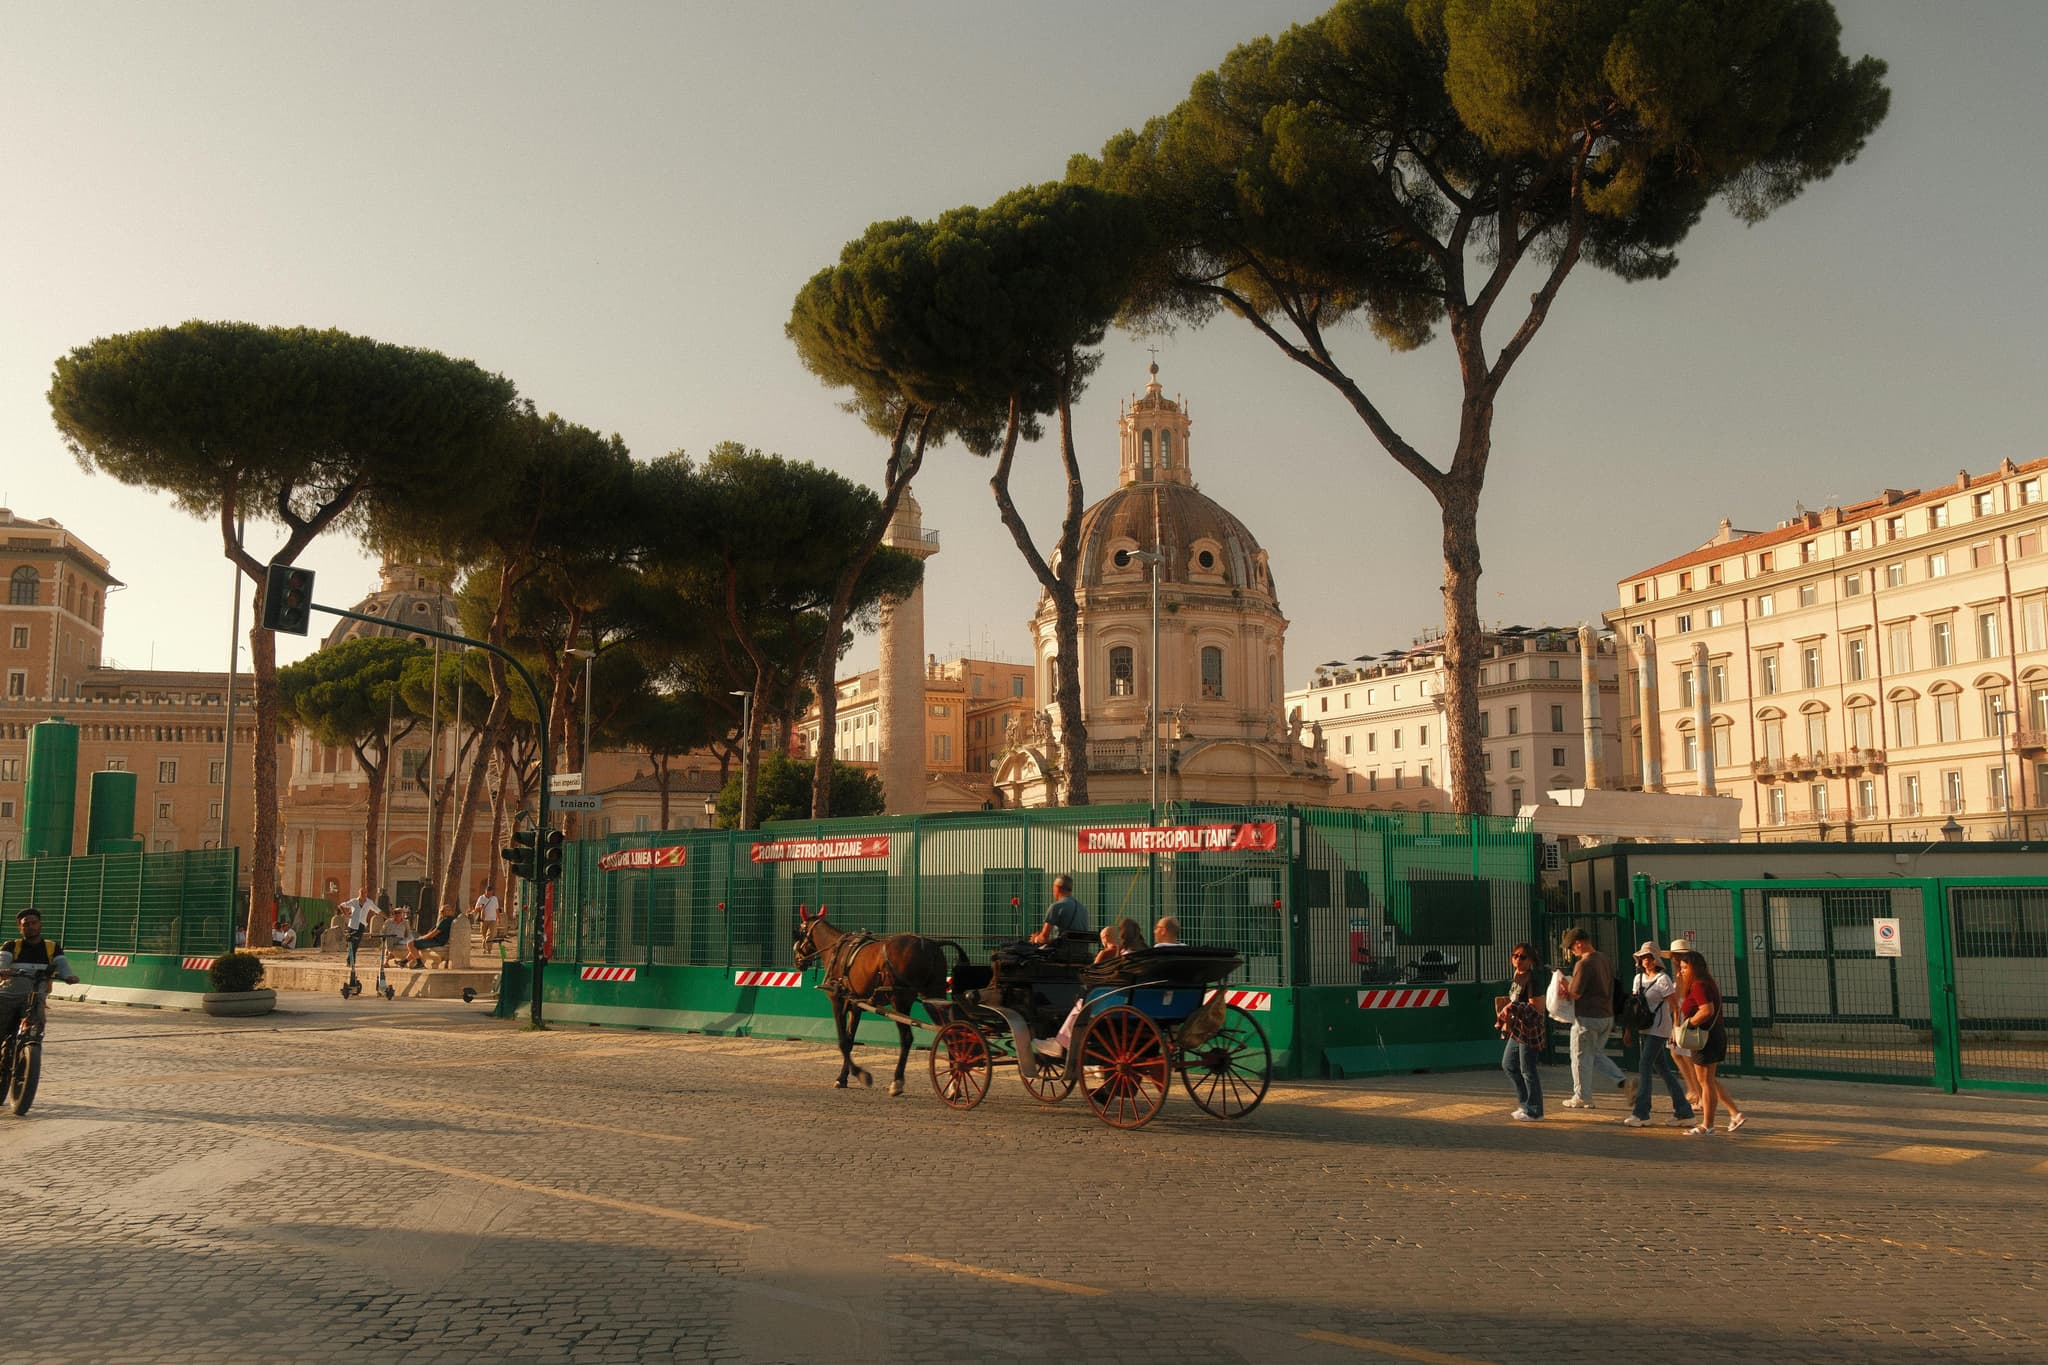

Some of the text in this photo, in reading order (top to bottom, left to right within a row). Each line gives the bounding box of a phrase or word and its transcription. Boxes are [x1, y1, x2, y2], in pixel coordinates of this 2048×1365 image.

[560, 799, 596, 808] traiano
[1088, 829, 1238, 850] ROMA METROPOLITANE
[631, 851, 652, 865] LINEA
[655, 851, 661, 865] C
[758, 841, 862, 860] ROMA METROPOLITANE
[1754, 935, 1764, 950] 2
